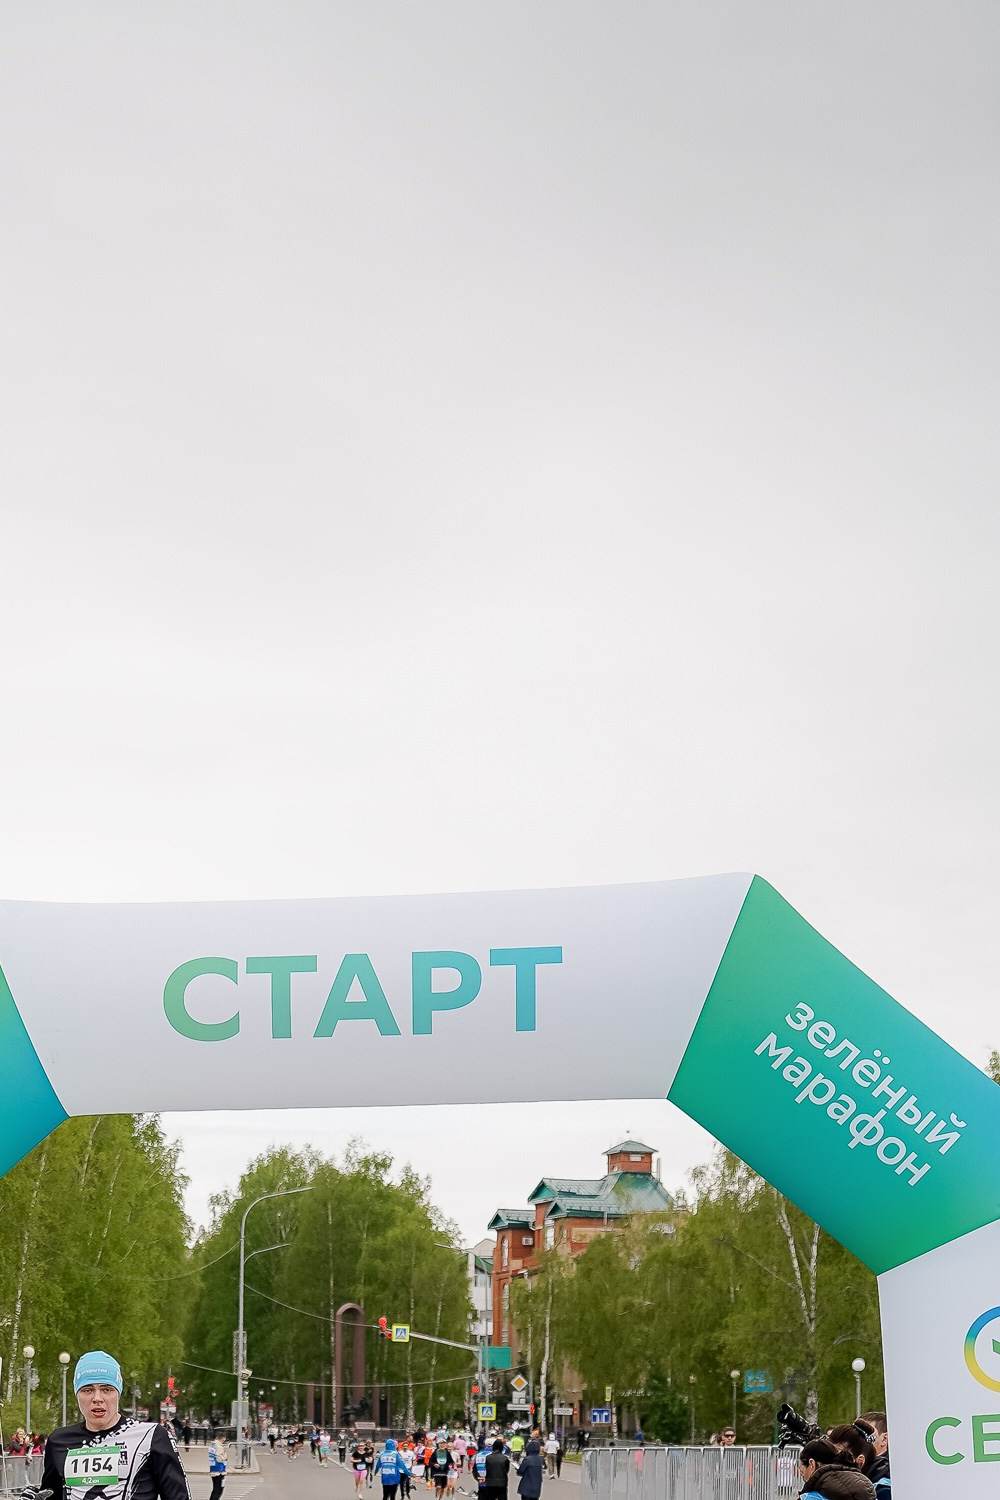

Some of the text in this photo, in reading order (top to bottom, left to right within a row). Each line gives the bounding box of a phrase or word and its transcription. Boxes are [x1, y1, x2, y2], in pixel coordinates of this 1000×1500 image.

[163, 945, 563, 1043] СТАРТ
[754, 1032, 932, 1187] марафон
[785, 1001, 967, 1155] зелёный
[70, 1456, 113, 1474] 1154
